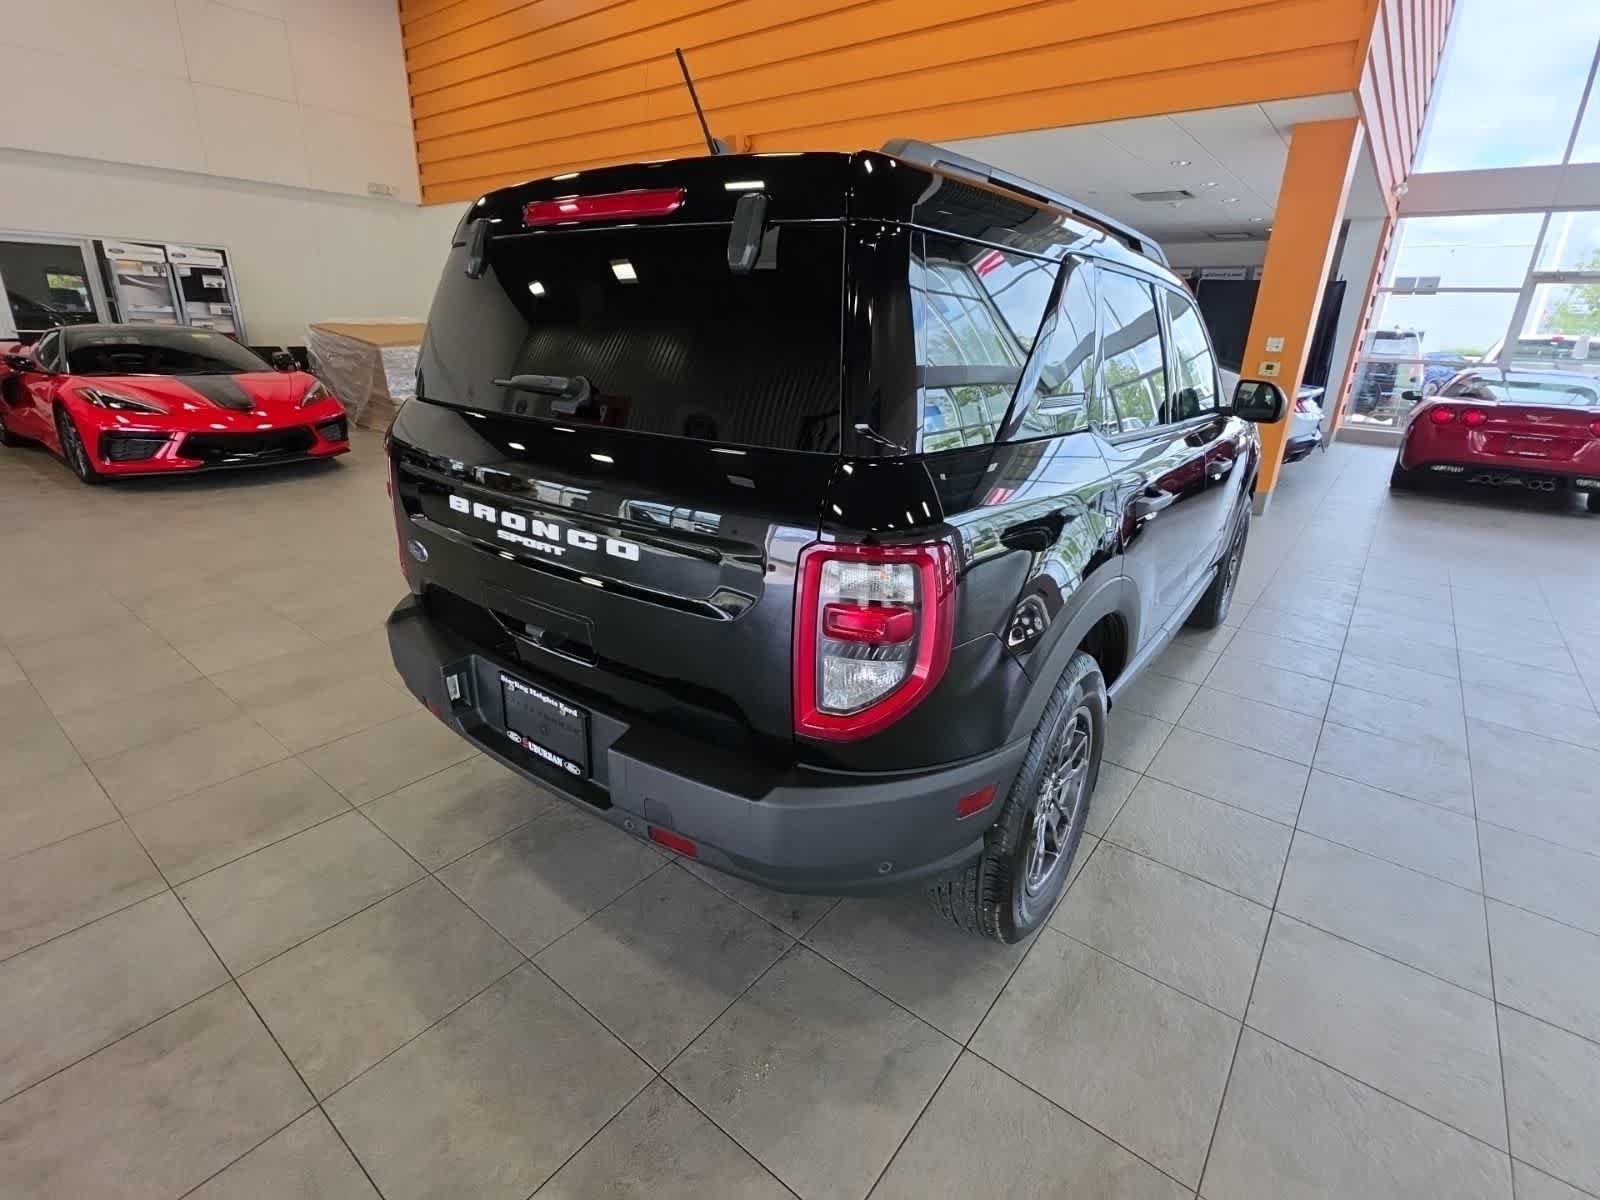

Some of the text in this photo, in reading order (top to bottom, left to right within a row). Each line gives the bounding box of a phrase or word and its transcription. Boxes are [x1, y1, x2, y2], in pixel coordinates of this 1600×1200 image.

[449, 494, 640, 562] BRONCO
[497, 529, 567, 556] SPORT
[522, 737, 562, 767] SUBURBAN
